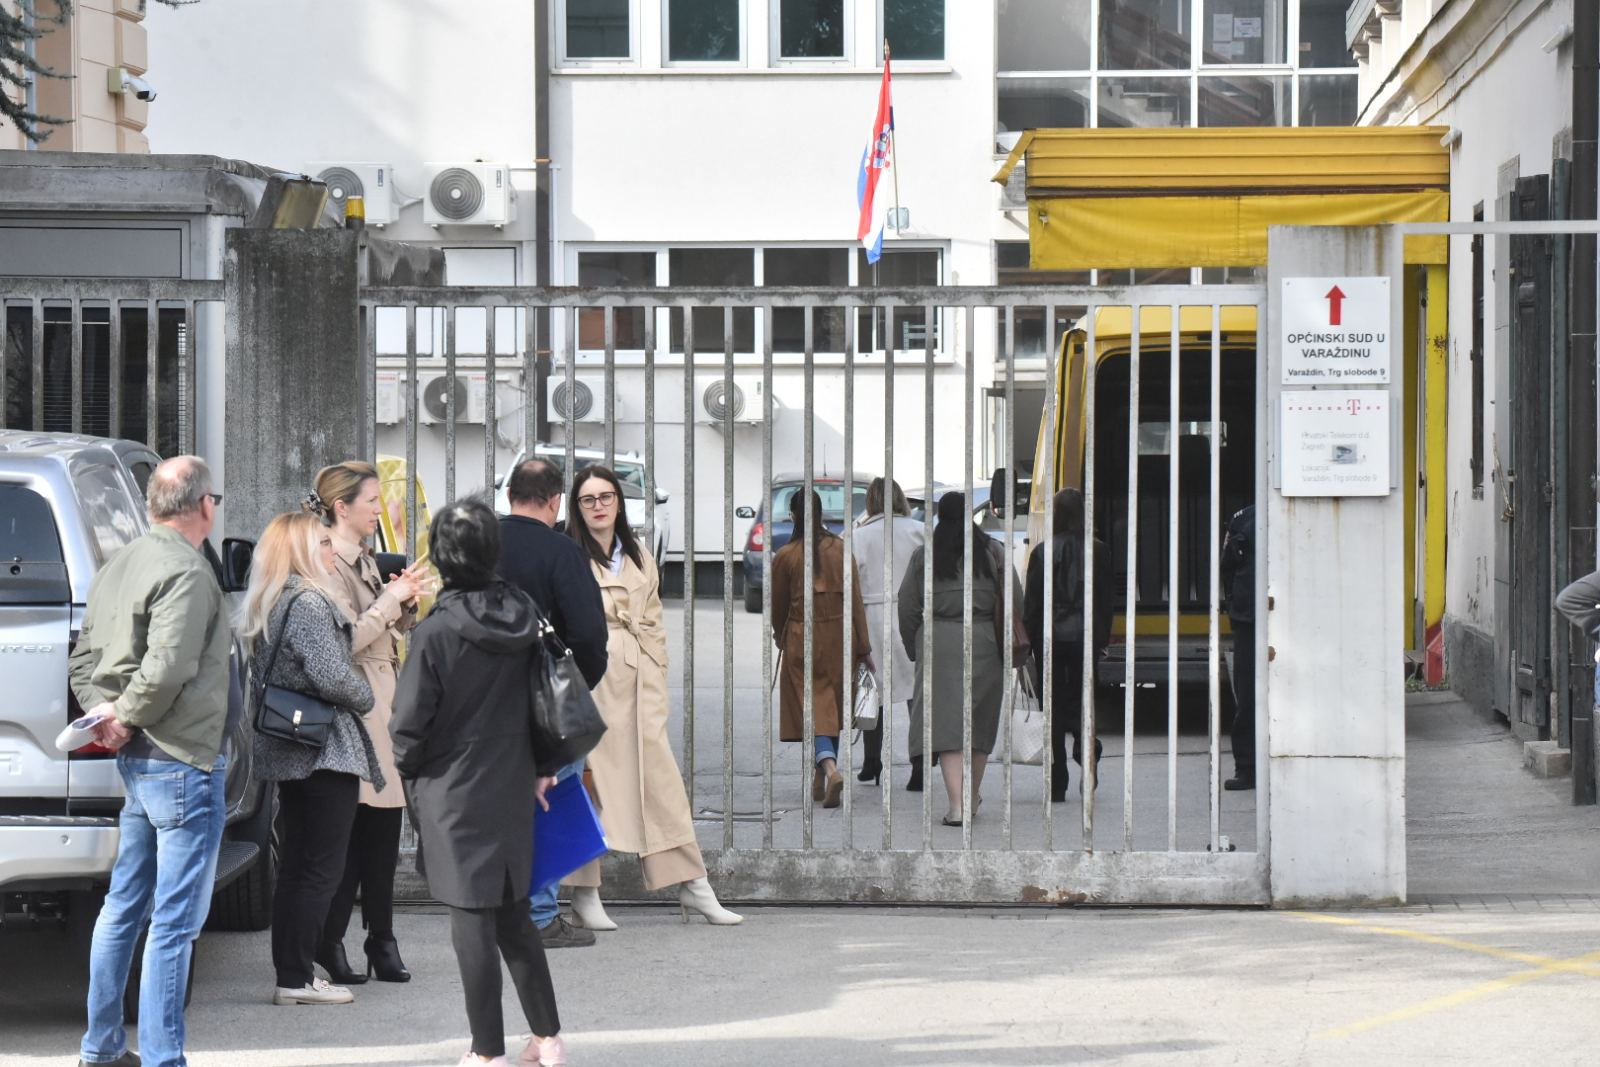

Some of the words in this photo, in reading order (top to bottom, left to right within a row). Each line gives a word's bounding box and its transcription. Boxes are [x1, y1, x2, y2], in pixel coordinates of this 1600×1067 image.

[1348, 333, 1373, 343] SUD
[1377, 333, 1385, 343] U
[1301, 347, 1371, 358] VARAŽDINU
[1288, 368, 1326, 376] Varaždin,
[1328, 368, 1341, 377] Trg
[1344, 368, 1377, 376] slobode
[1380, 368, 1385, 376] 9
